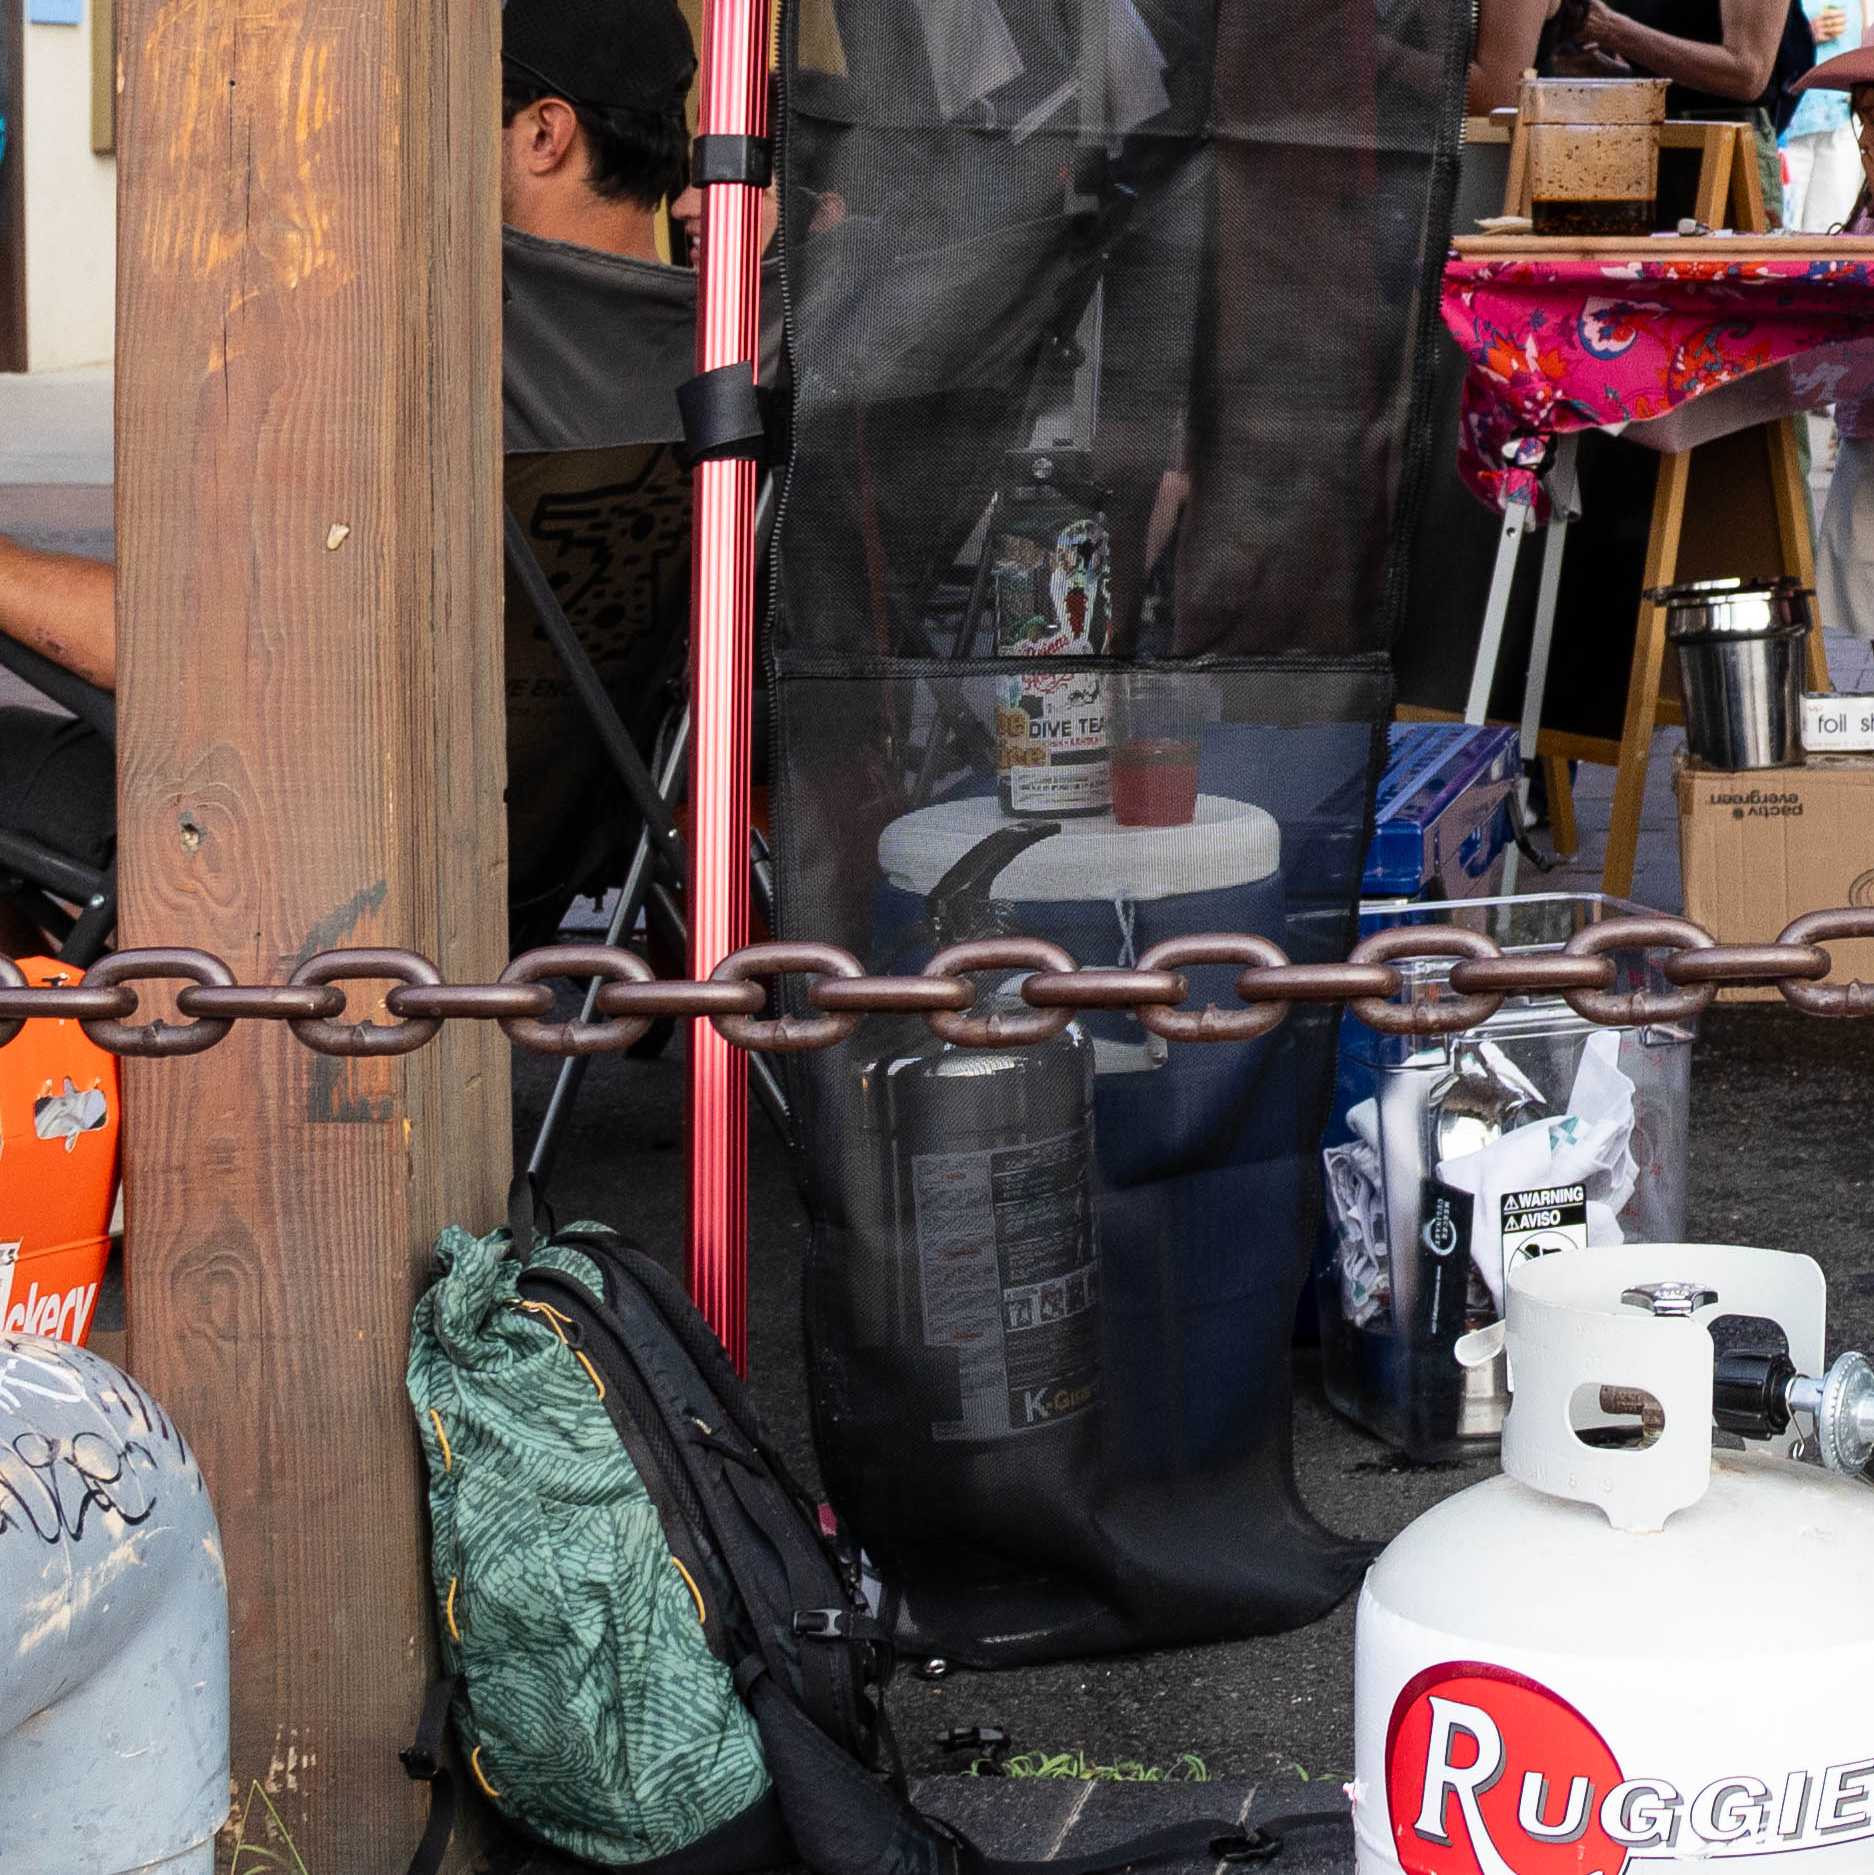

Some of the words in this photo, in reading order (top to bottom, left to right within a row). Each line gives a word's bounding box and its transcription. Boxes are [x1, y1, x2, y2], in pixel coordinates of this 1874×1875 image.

[1029, 720, 1072, 739] DIVE
[1710, 791, 1799, 807] evergreen
[1747, 802, 1804, 819] pactiv
[1518, 1185, 1584, 1209] WARNING
[1441, 1200, 1451, 1241] MERCER
[1519, 1209, 1561, 1230] AVISO
